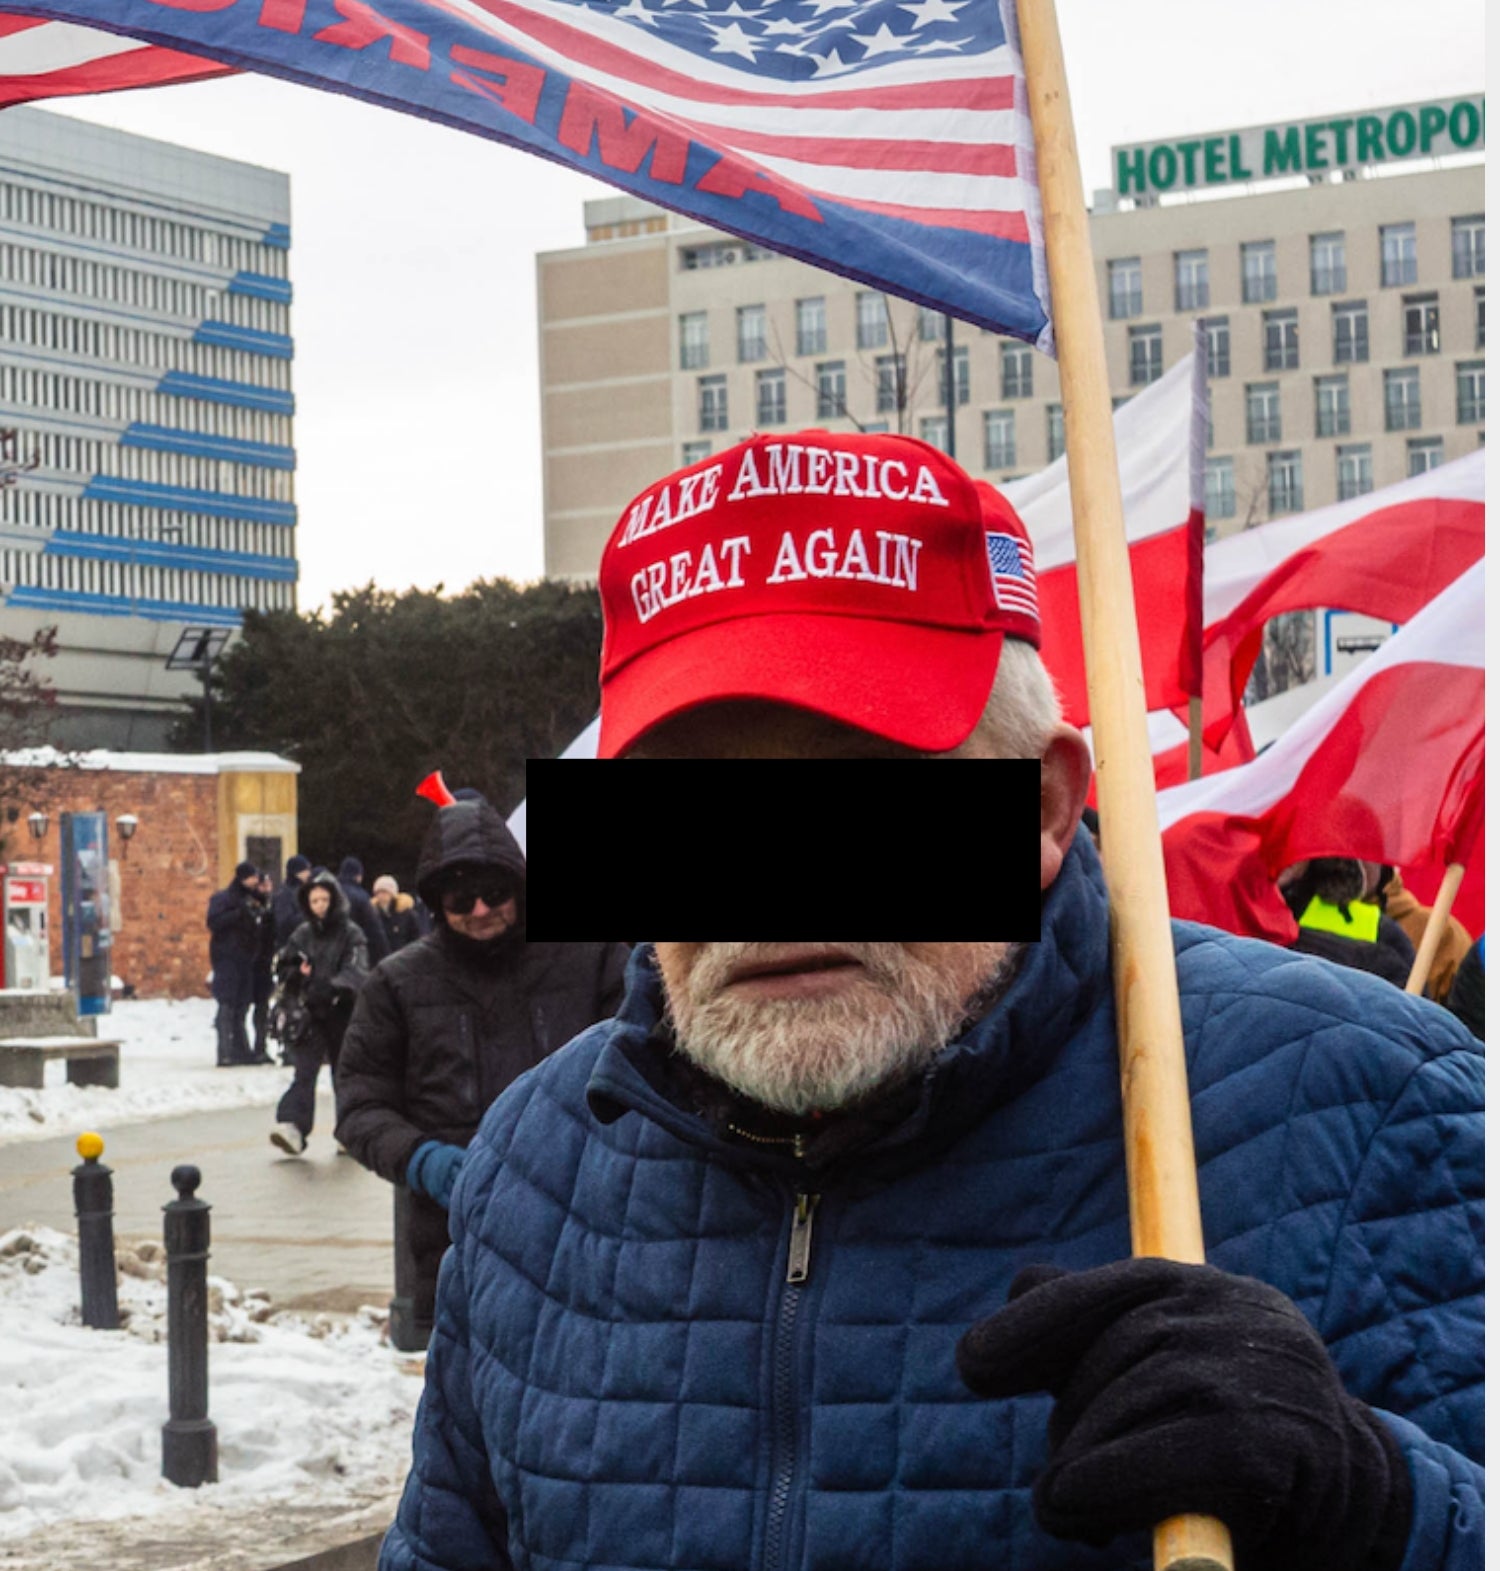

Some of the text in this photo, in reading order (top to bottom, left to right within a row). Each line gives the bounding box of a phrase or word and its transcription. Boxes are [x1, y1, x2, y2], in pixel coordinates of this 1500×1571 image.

[1117, 98, 1485, 195] HOTEL METROPO
[618, 444, 949, 548] MAKE AMERICA
[630, 527, 923, 624] GREAT AGAIN
